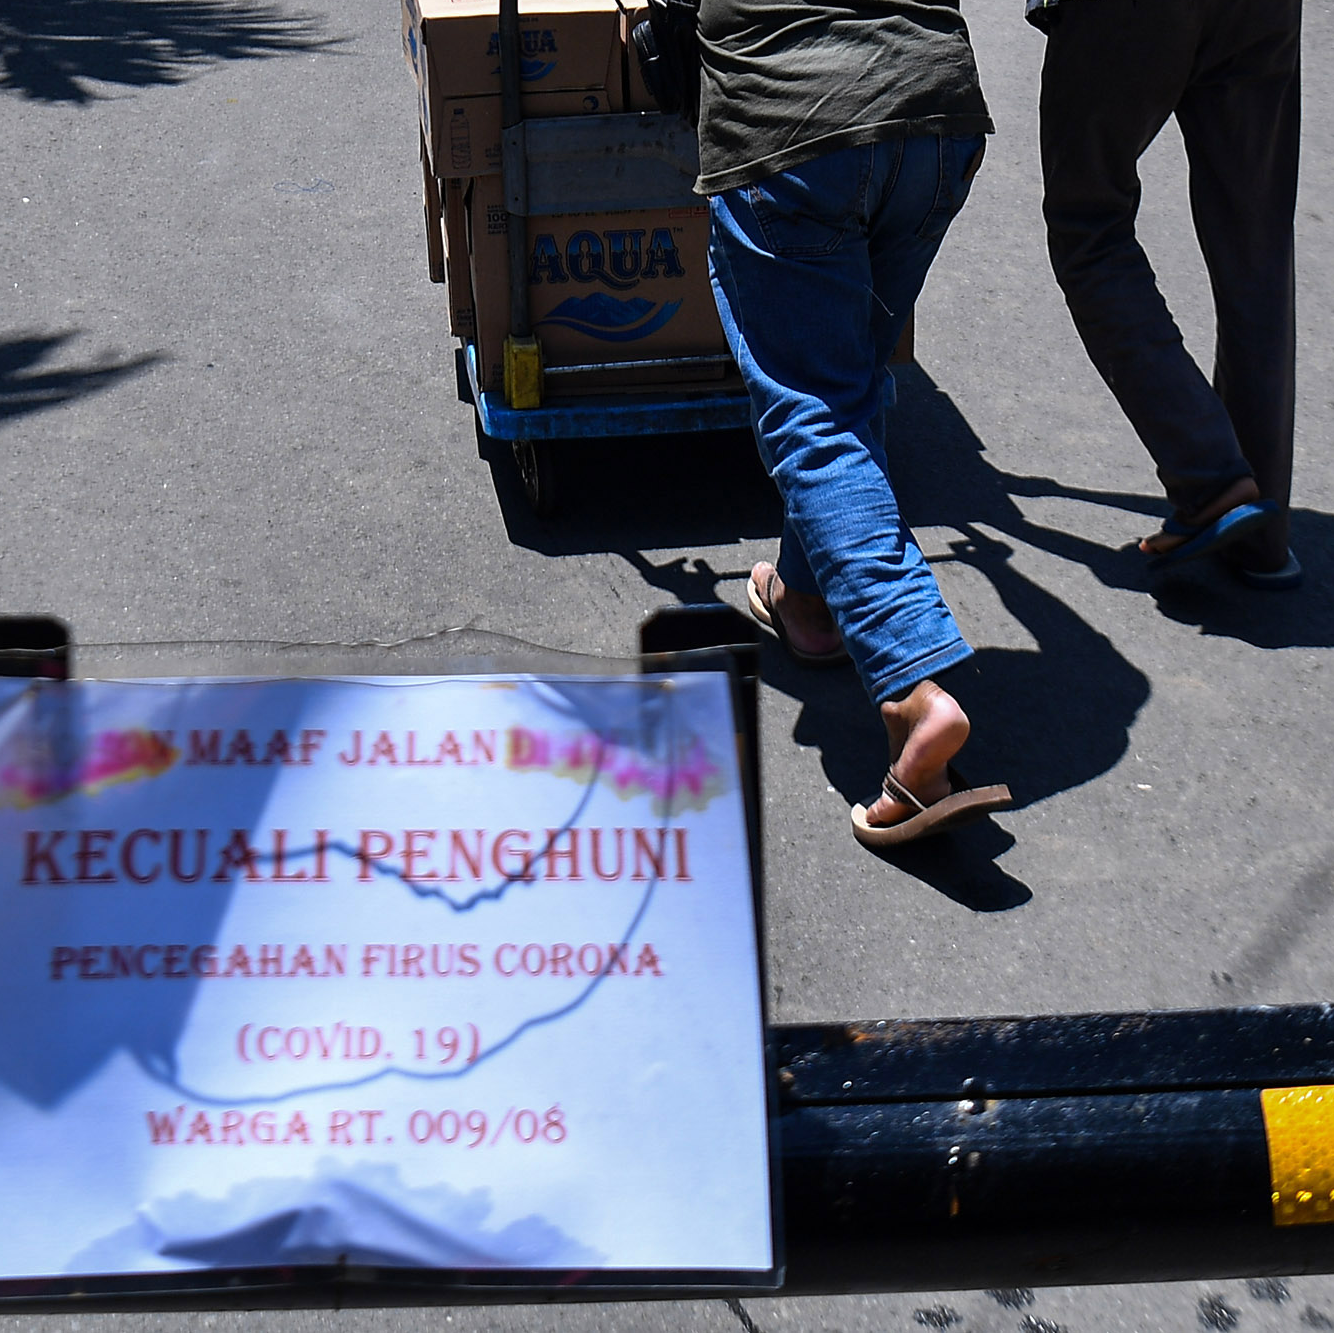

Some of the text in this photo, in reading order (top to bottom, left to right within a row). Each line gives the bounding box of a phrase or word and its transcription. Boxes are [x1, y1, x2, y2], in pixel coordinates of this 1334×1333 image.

[486, 29, 558, 58] AUA
[530, 227, 685, 291] AQUA
[185, 729, 328, 766] MAAF
[338, 729, 497, 767] JALAN
[21, 826, 693, 885] KECUALI PENGHUNI
[49, 942, 665, 981] PENCEGAHAN FIRUS CORONA
[236, 1020, 480, 1064] (COVID. 19)
[146, 1103, 568, 1149] WARGA RT. 009/08
